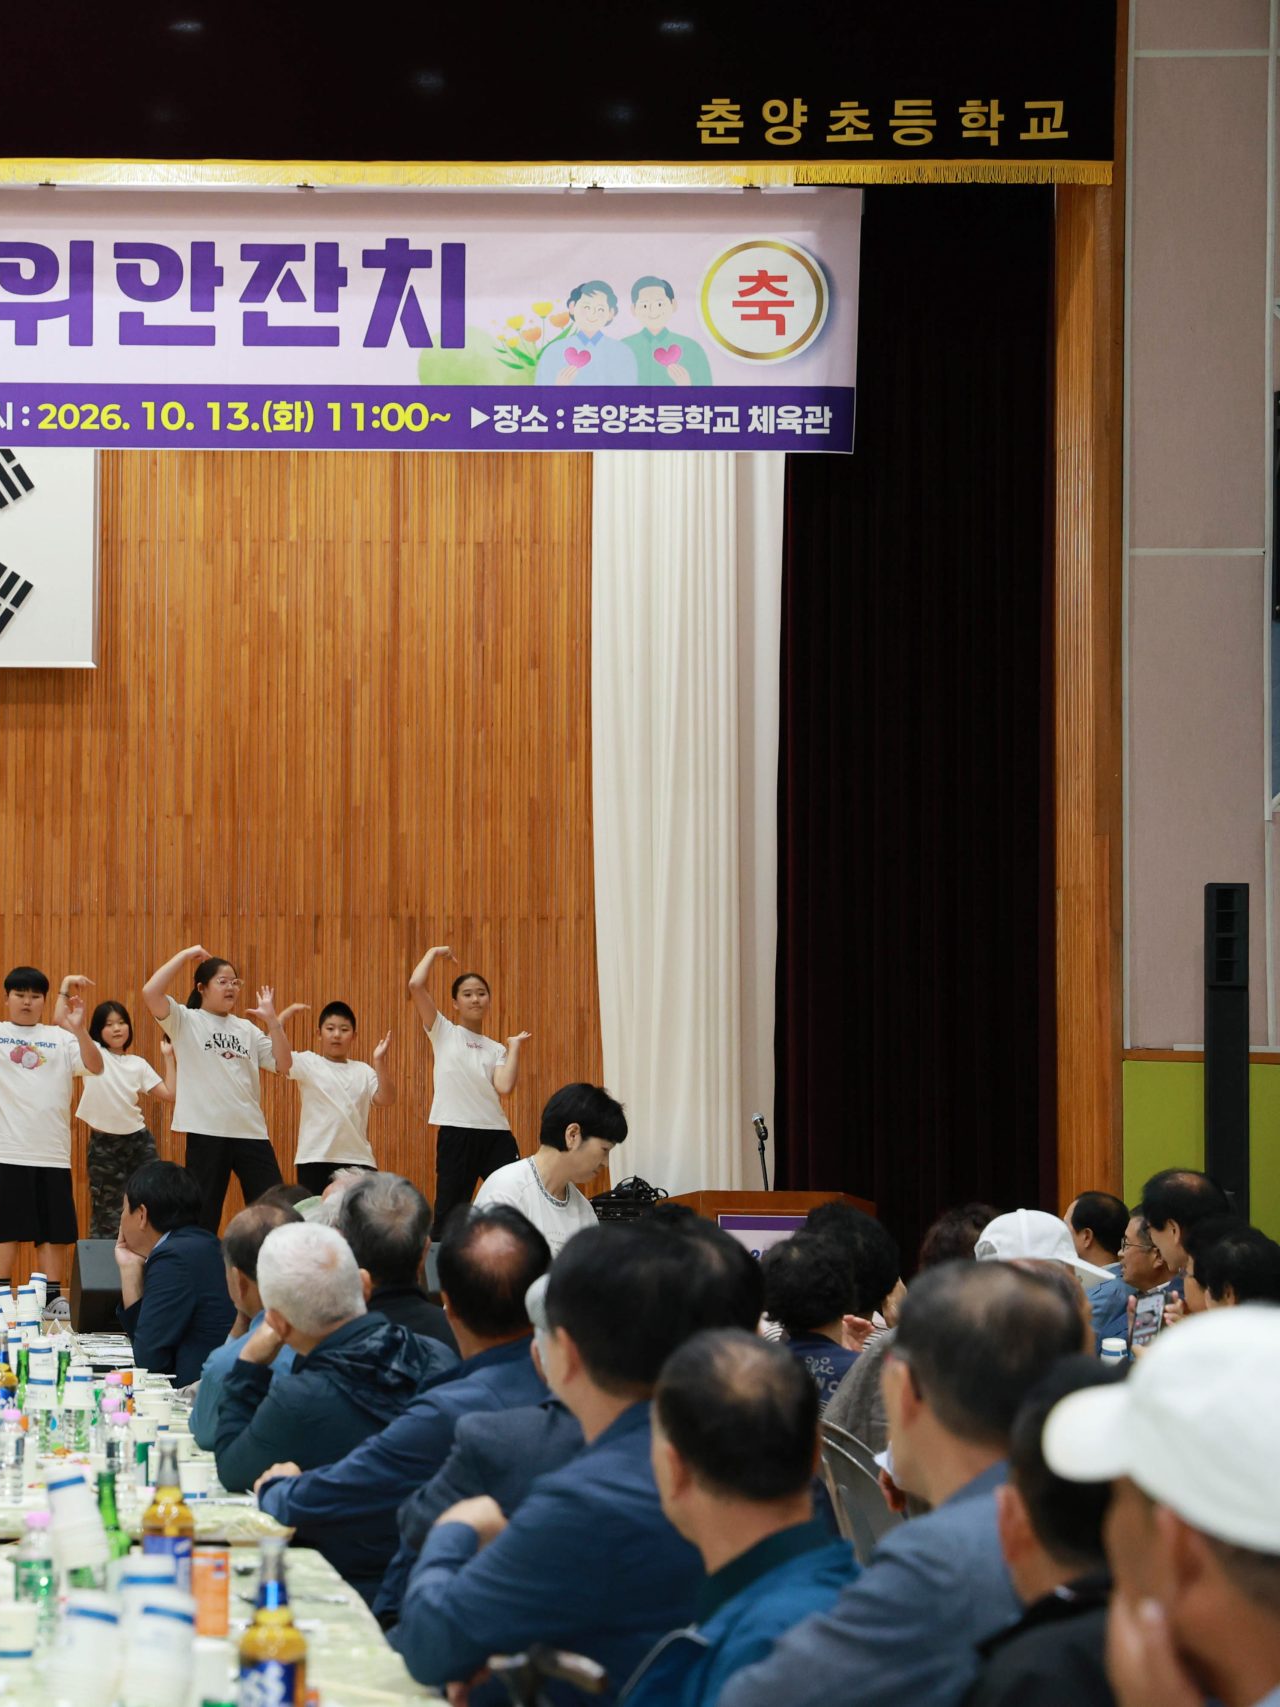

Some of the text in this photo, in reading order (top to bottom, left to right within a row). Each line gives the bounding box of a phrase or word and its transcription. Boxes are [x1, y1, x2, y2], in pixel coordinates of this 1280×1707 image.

[696, 98, 1069, 146] 춘양초등학교
[732, 269, 795, 336] 축
[37, 402, 131, 431] 2026.
[141, 400, 195, 431] 10.
[206, 400, 315, 434] 13.(화)
[327, 402, 451, 433] 11:00~
[493, 404, 549, 434] 장소
[572, 404, 741, 435] 춘양초등학교
[747, 405, 833, 435] 체육관
